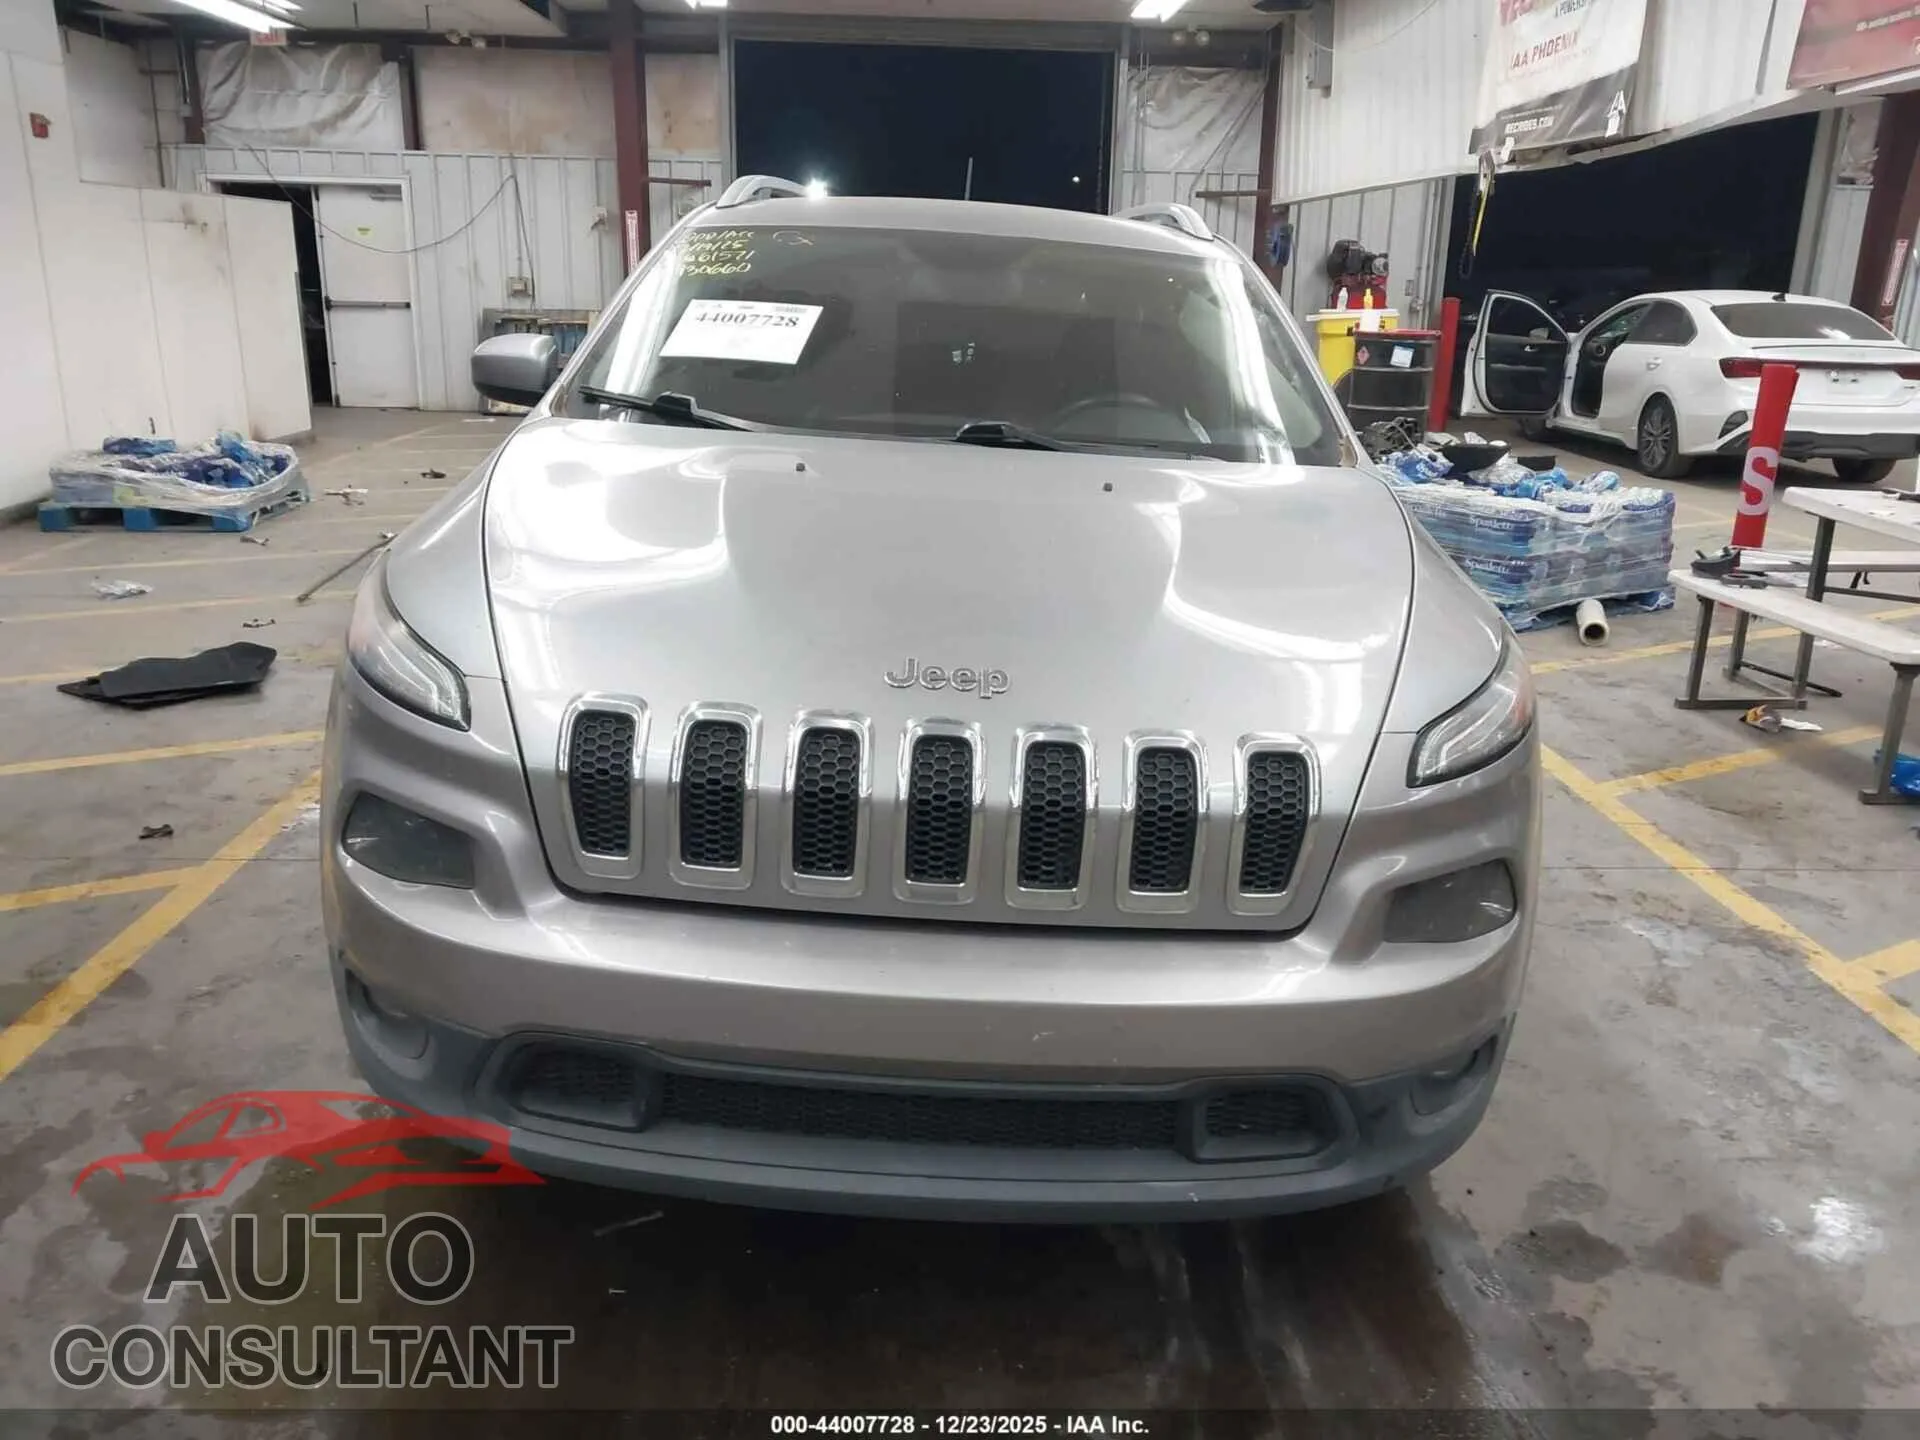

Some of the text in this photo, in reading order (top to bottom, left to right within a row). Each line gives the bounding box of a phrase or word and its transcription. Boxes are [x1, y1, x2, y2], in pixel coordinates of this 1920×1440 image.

[696, 312, 800, 327] 44007728
[1737, 446, 1779, 516] S
[883, 656, 1010, 700] Jeep
